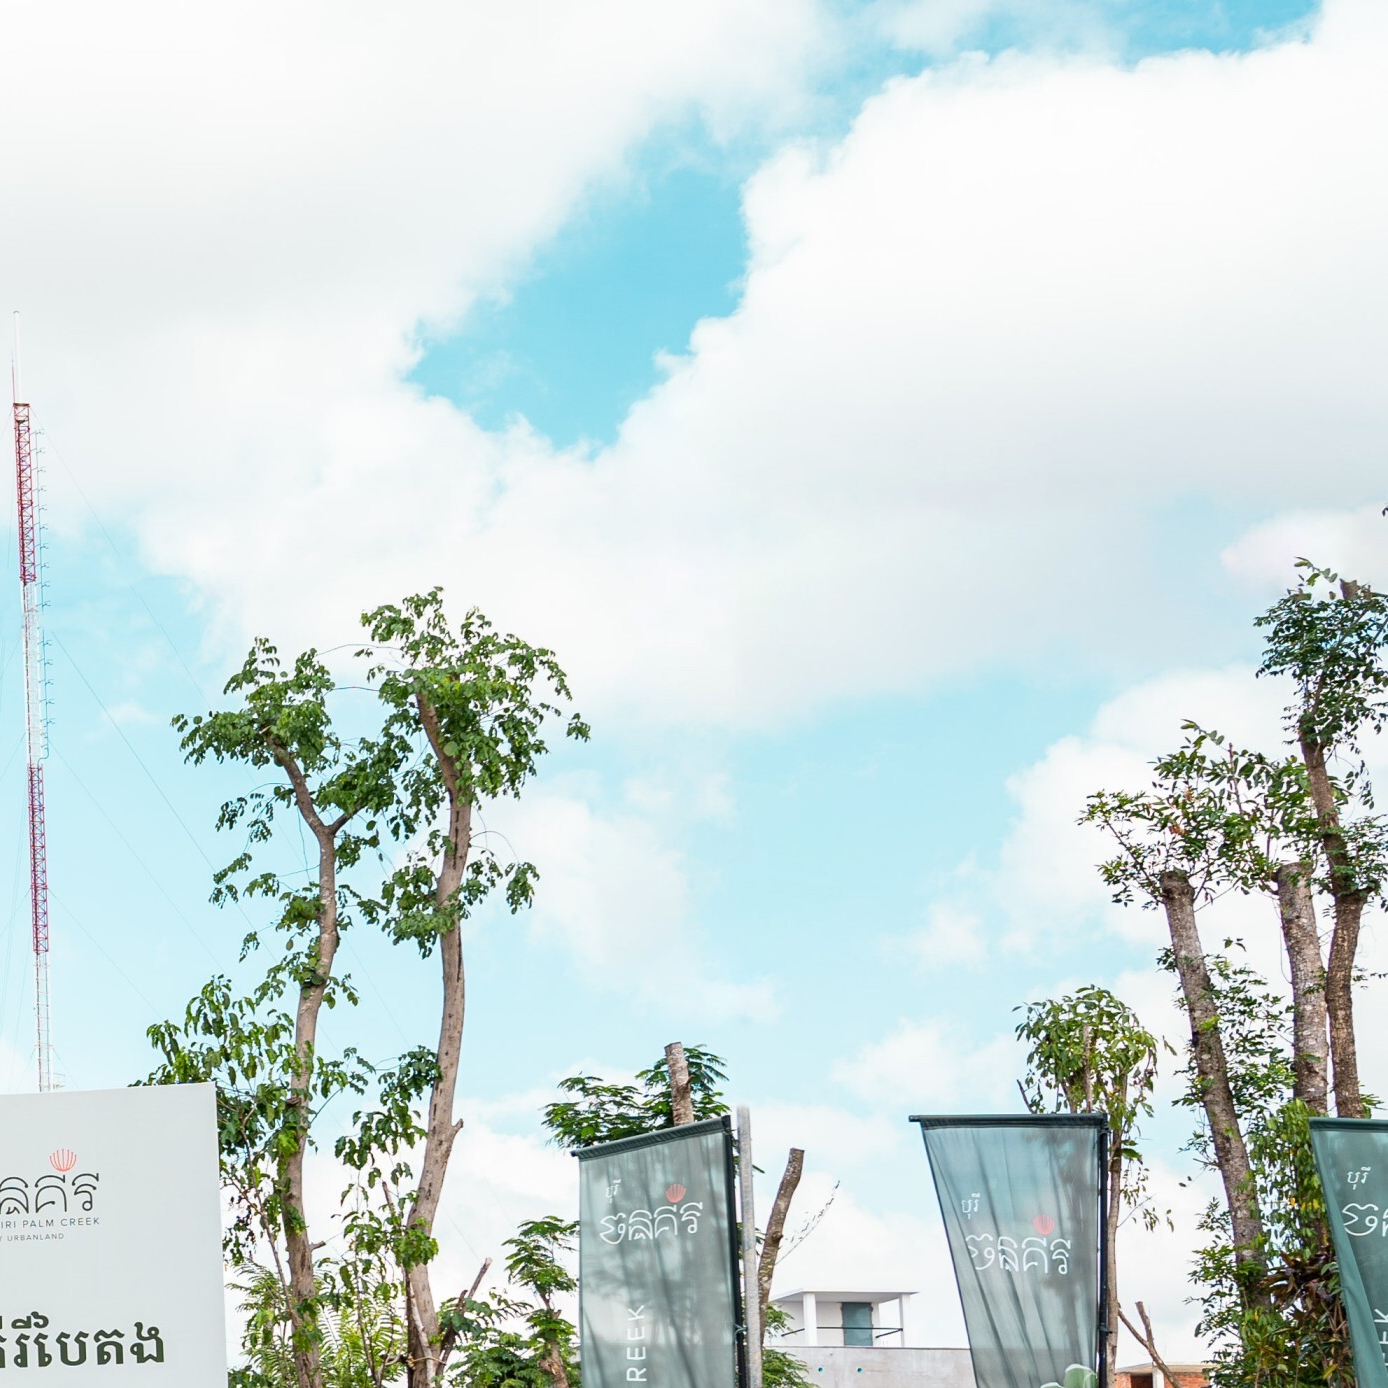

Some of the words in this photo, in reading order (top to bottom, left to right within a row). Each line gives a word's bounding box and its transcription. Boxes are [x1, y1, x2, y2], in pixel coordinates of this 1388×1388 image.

[22, 1219, 54, 1228] PALM
[60, 1217, 100, 1227] CREEK
[7, 1232, 64, 1242] URBANLAND
